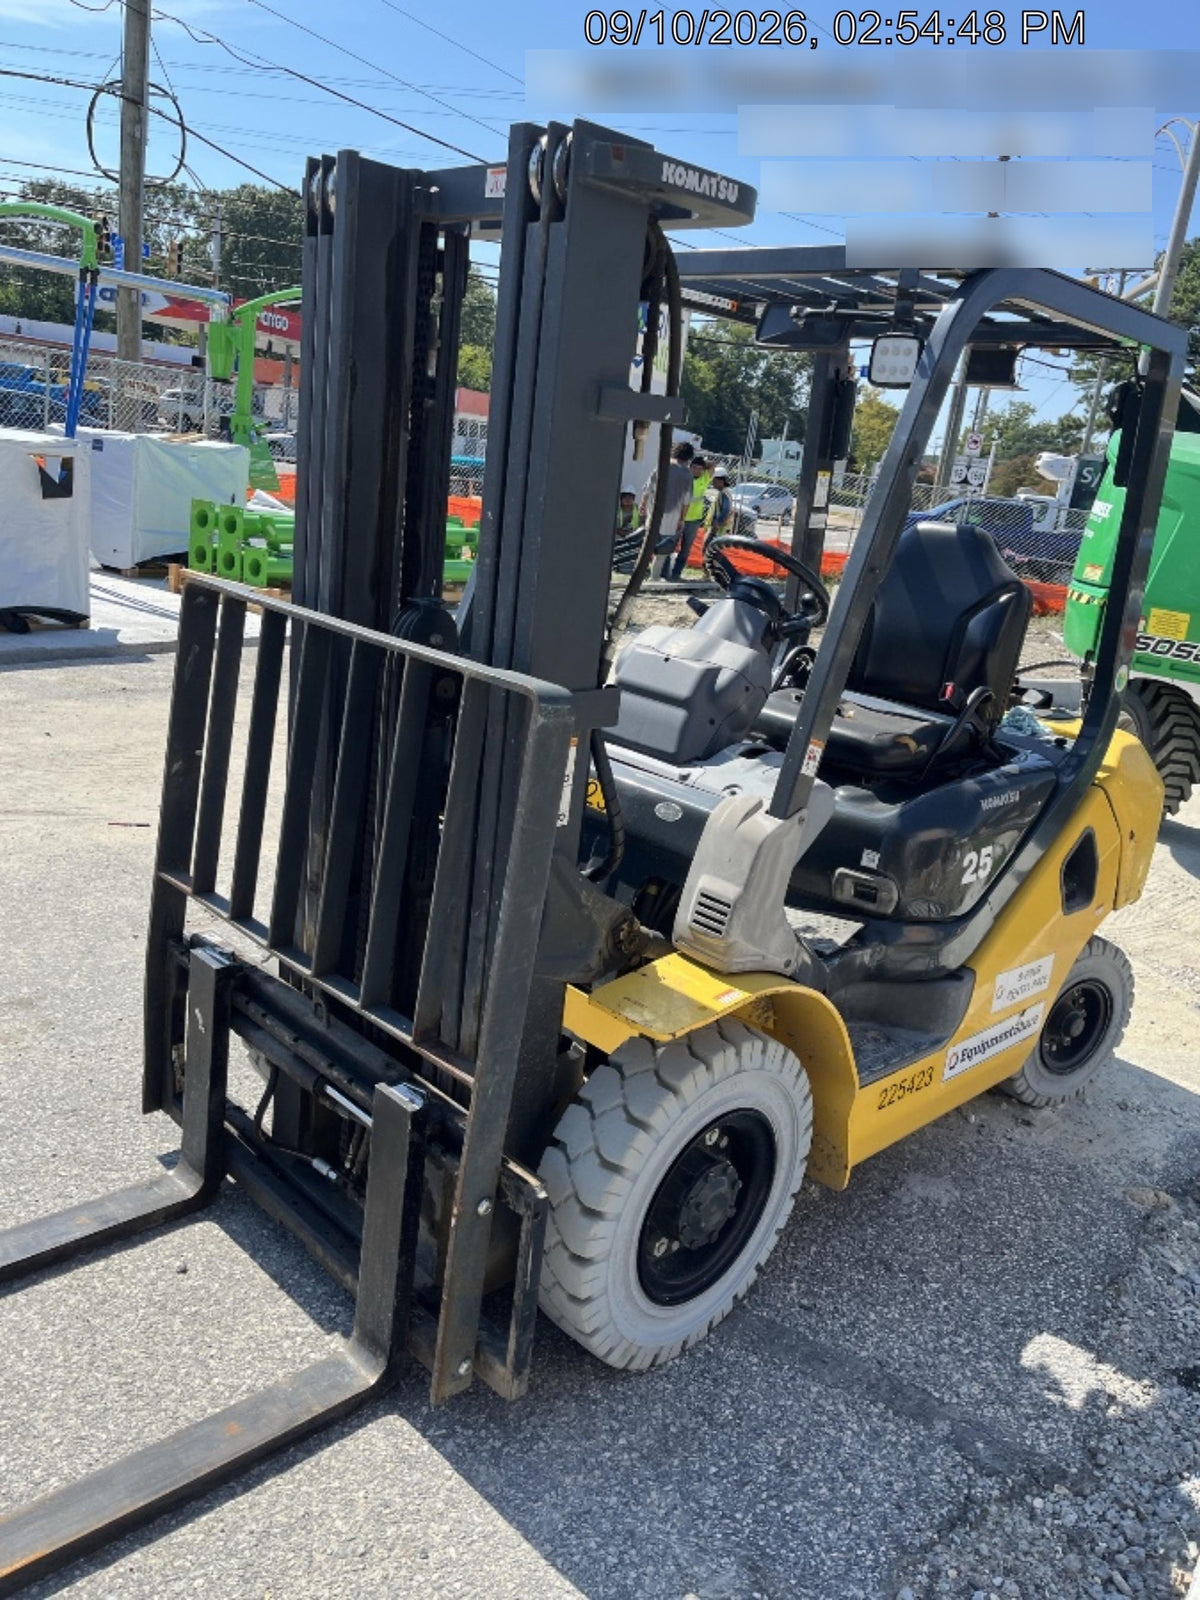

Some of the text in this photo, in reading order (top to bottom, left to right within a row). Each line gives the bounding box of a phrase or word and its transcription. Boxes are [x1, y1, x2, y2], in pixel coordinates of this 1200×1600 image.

[661, 161, 739, 203] KOMATSU
[961, 845, 993, 885] 25
[878, 1066, 934, 1110] 225423
